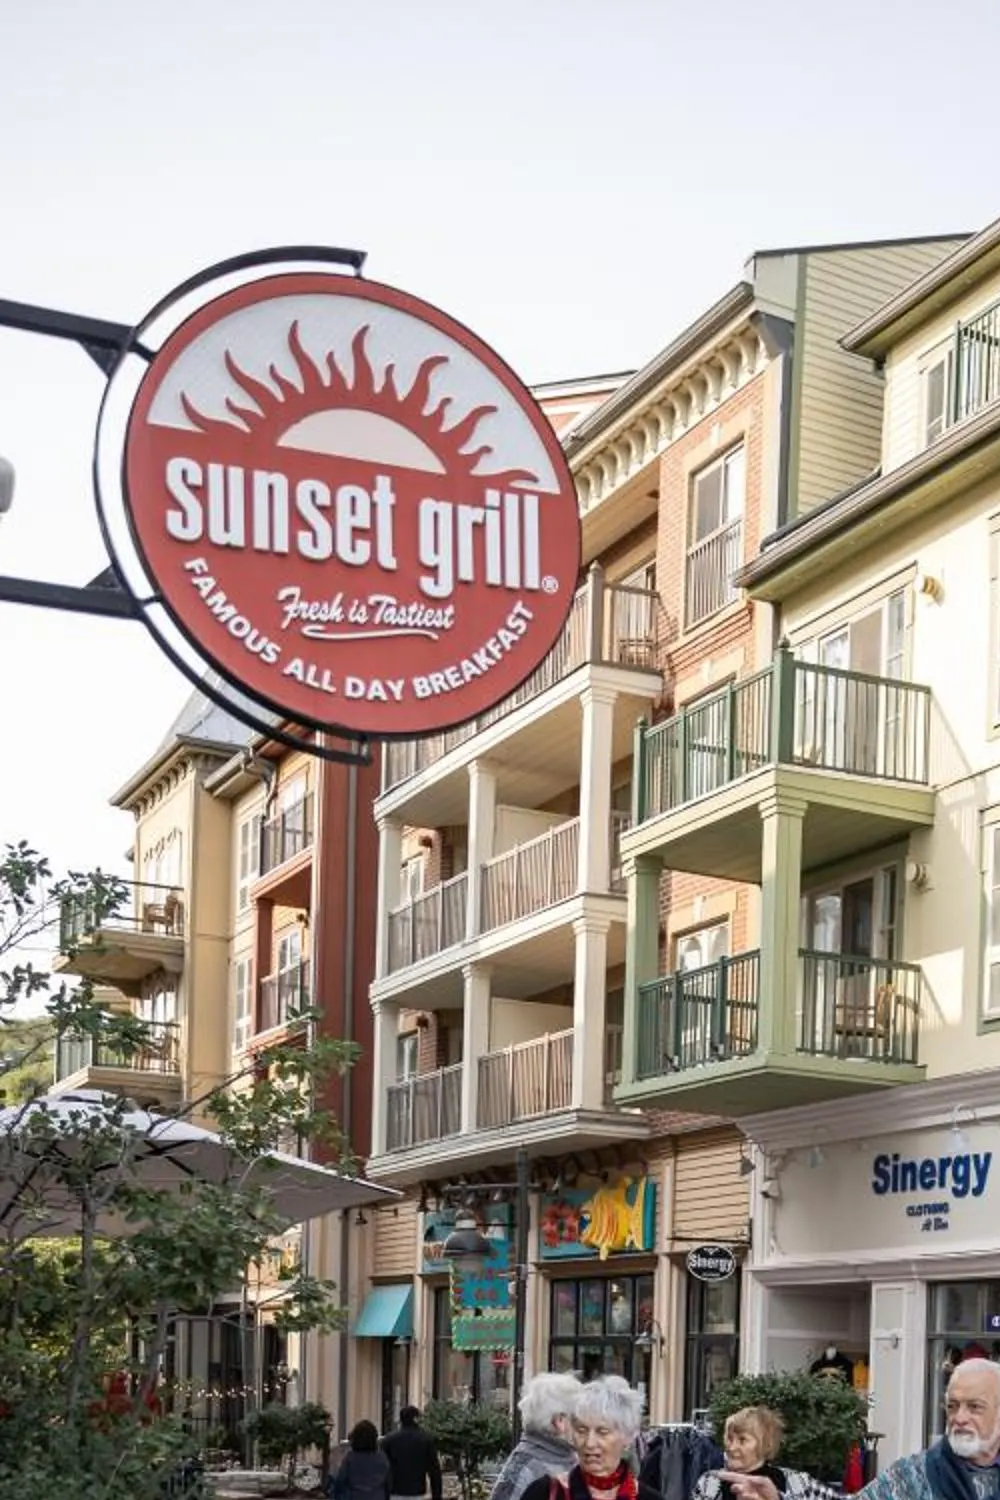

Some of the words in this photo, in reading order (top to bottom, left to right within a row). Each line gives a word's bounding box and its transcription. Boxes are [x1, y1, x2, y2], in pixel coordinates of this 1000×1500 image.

[165, 456, 398, 571] sunset
[419, 487, 540, 599] grill
[184, 557, 282, 664] FAMOUS
[283, 657, 337, 693] ALL
[344, 675, 405, 700] DAY
[412, 600, 534, 699] BREAKFAST
[277, 586, 344, 629] Fresh
[349, 599, 369, 624] is
[368, 593, 455, 629] Tastiest
[872, 1151, 993, 1198] Sinergy
[688, 1253, 733, 1273] Sinergy
